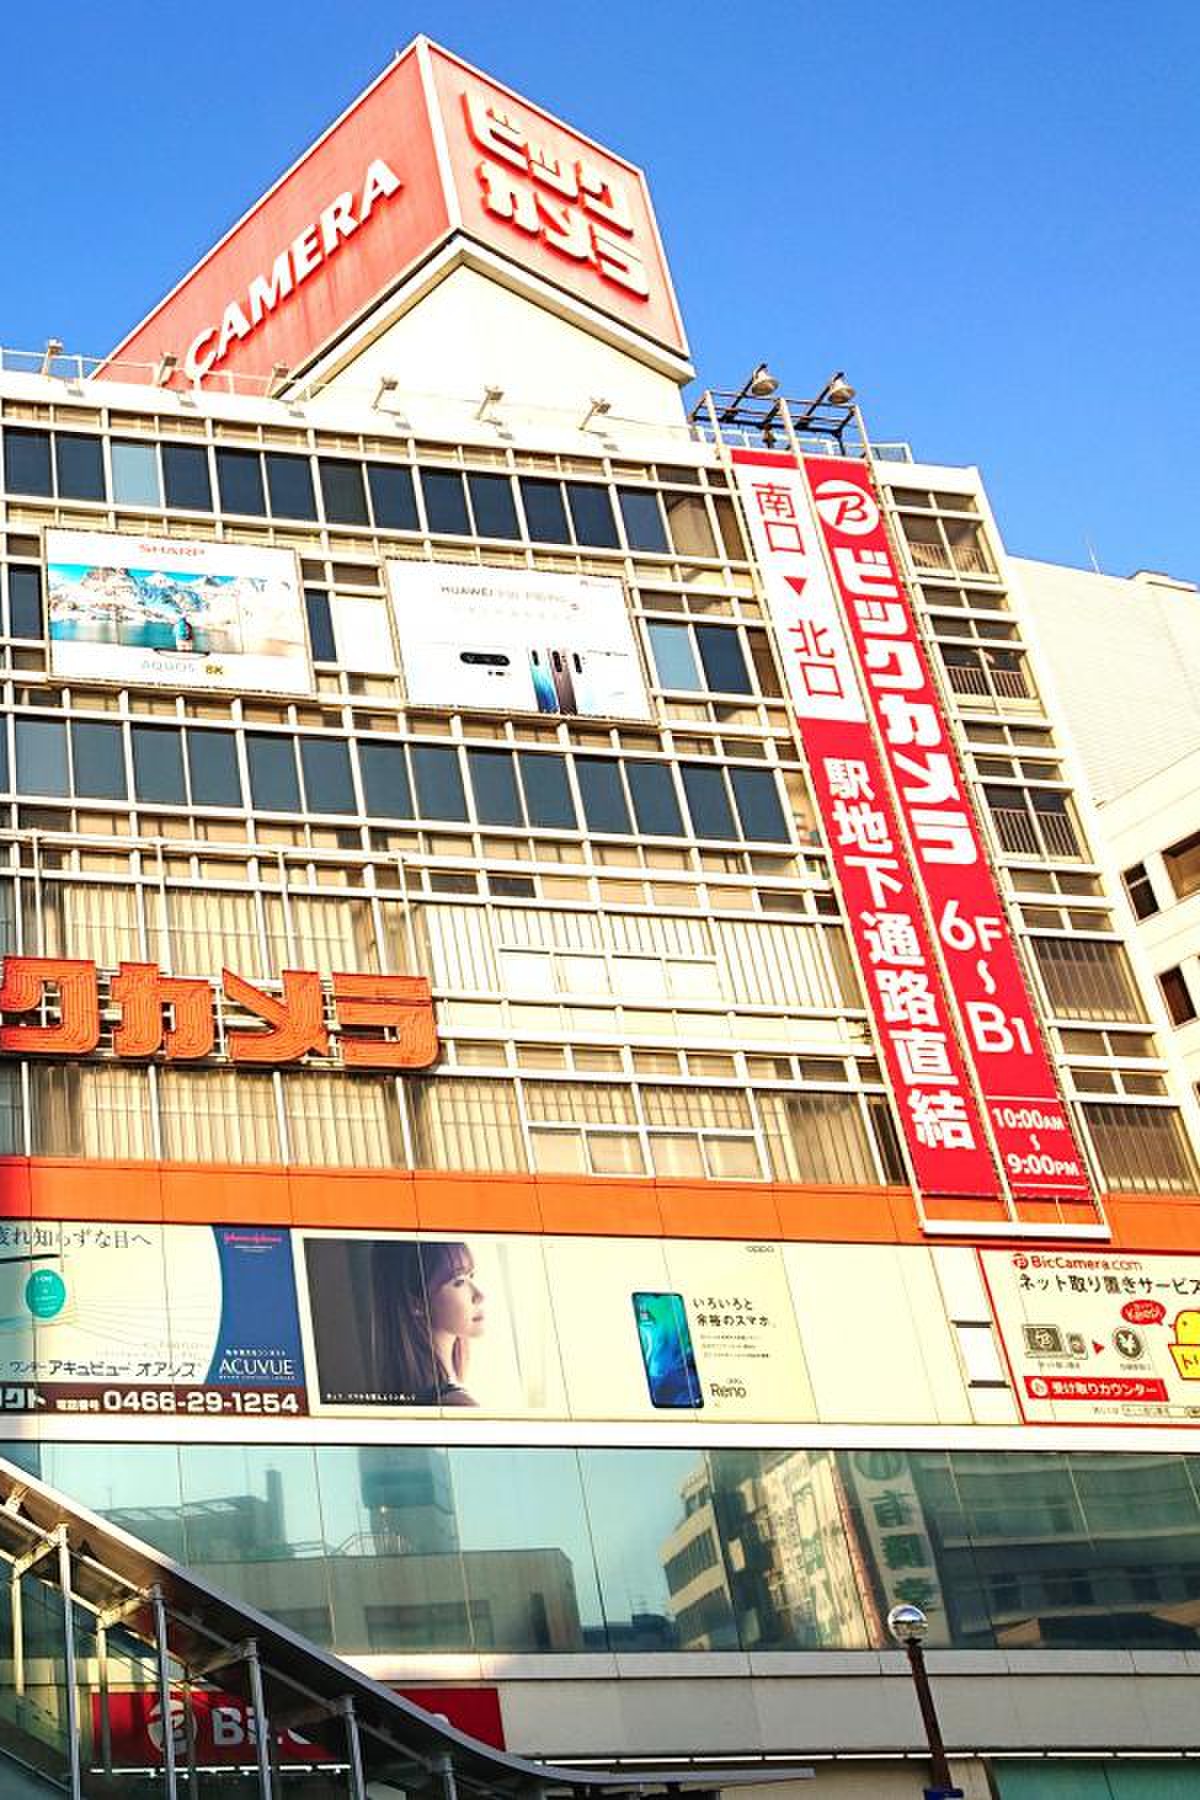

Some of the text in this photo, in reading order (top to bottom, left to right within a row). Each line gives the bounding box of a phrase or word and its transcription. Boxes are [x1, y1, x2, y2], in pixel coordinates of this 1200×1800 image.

[461, 91, 633, 237] ビック
[479, 161, 650, 301] カメラ
[184, 158, 401, 382] CAMERA
[137, 543, 205, 557] SHARP
[751, 481, 845, 700] 南口 北口
[833, 546, 978, 865] ビックカメラ
[939, 899, 1003, 952] 6F
[822, 757, 977, 1151] 駅地下通路直結
[964, 1000, 1034, 1056] B1
[1007, 1153, 1080, 1178] 9:00PM
[692, 1297, 754, 1312] いろいろと
[218, 1358, 295, 1376] ACUVUE
[709, 1383, 748, 1399] Reno
[103, 1390, 299, 1413] 0466-29-1254
